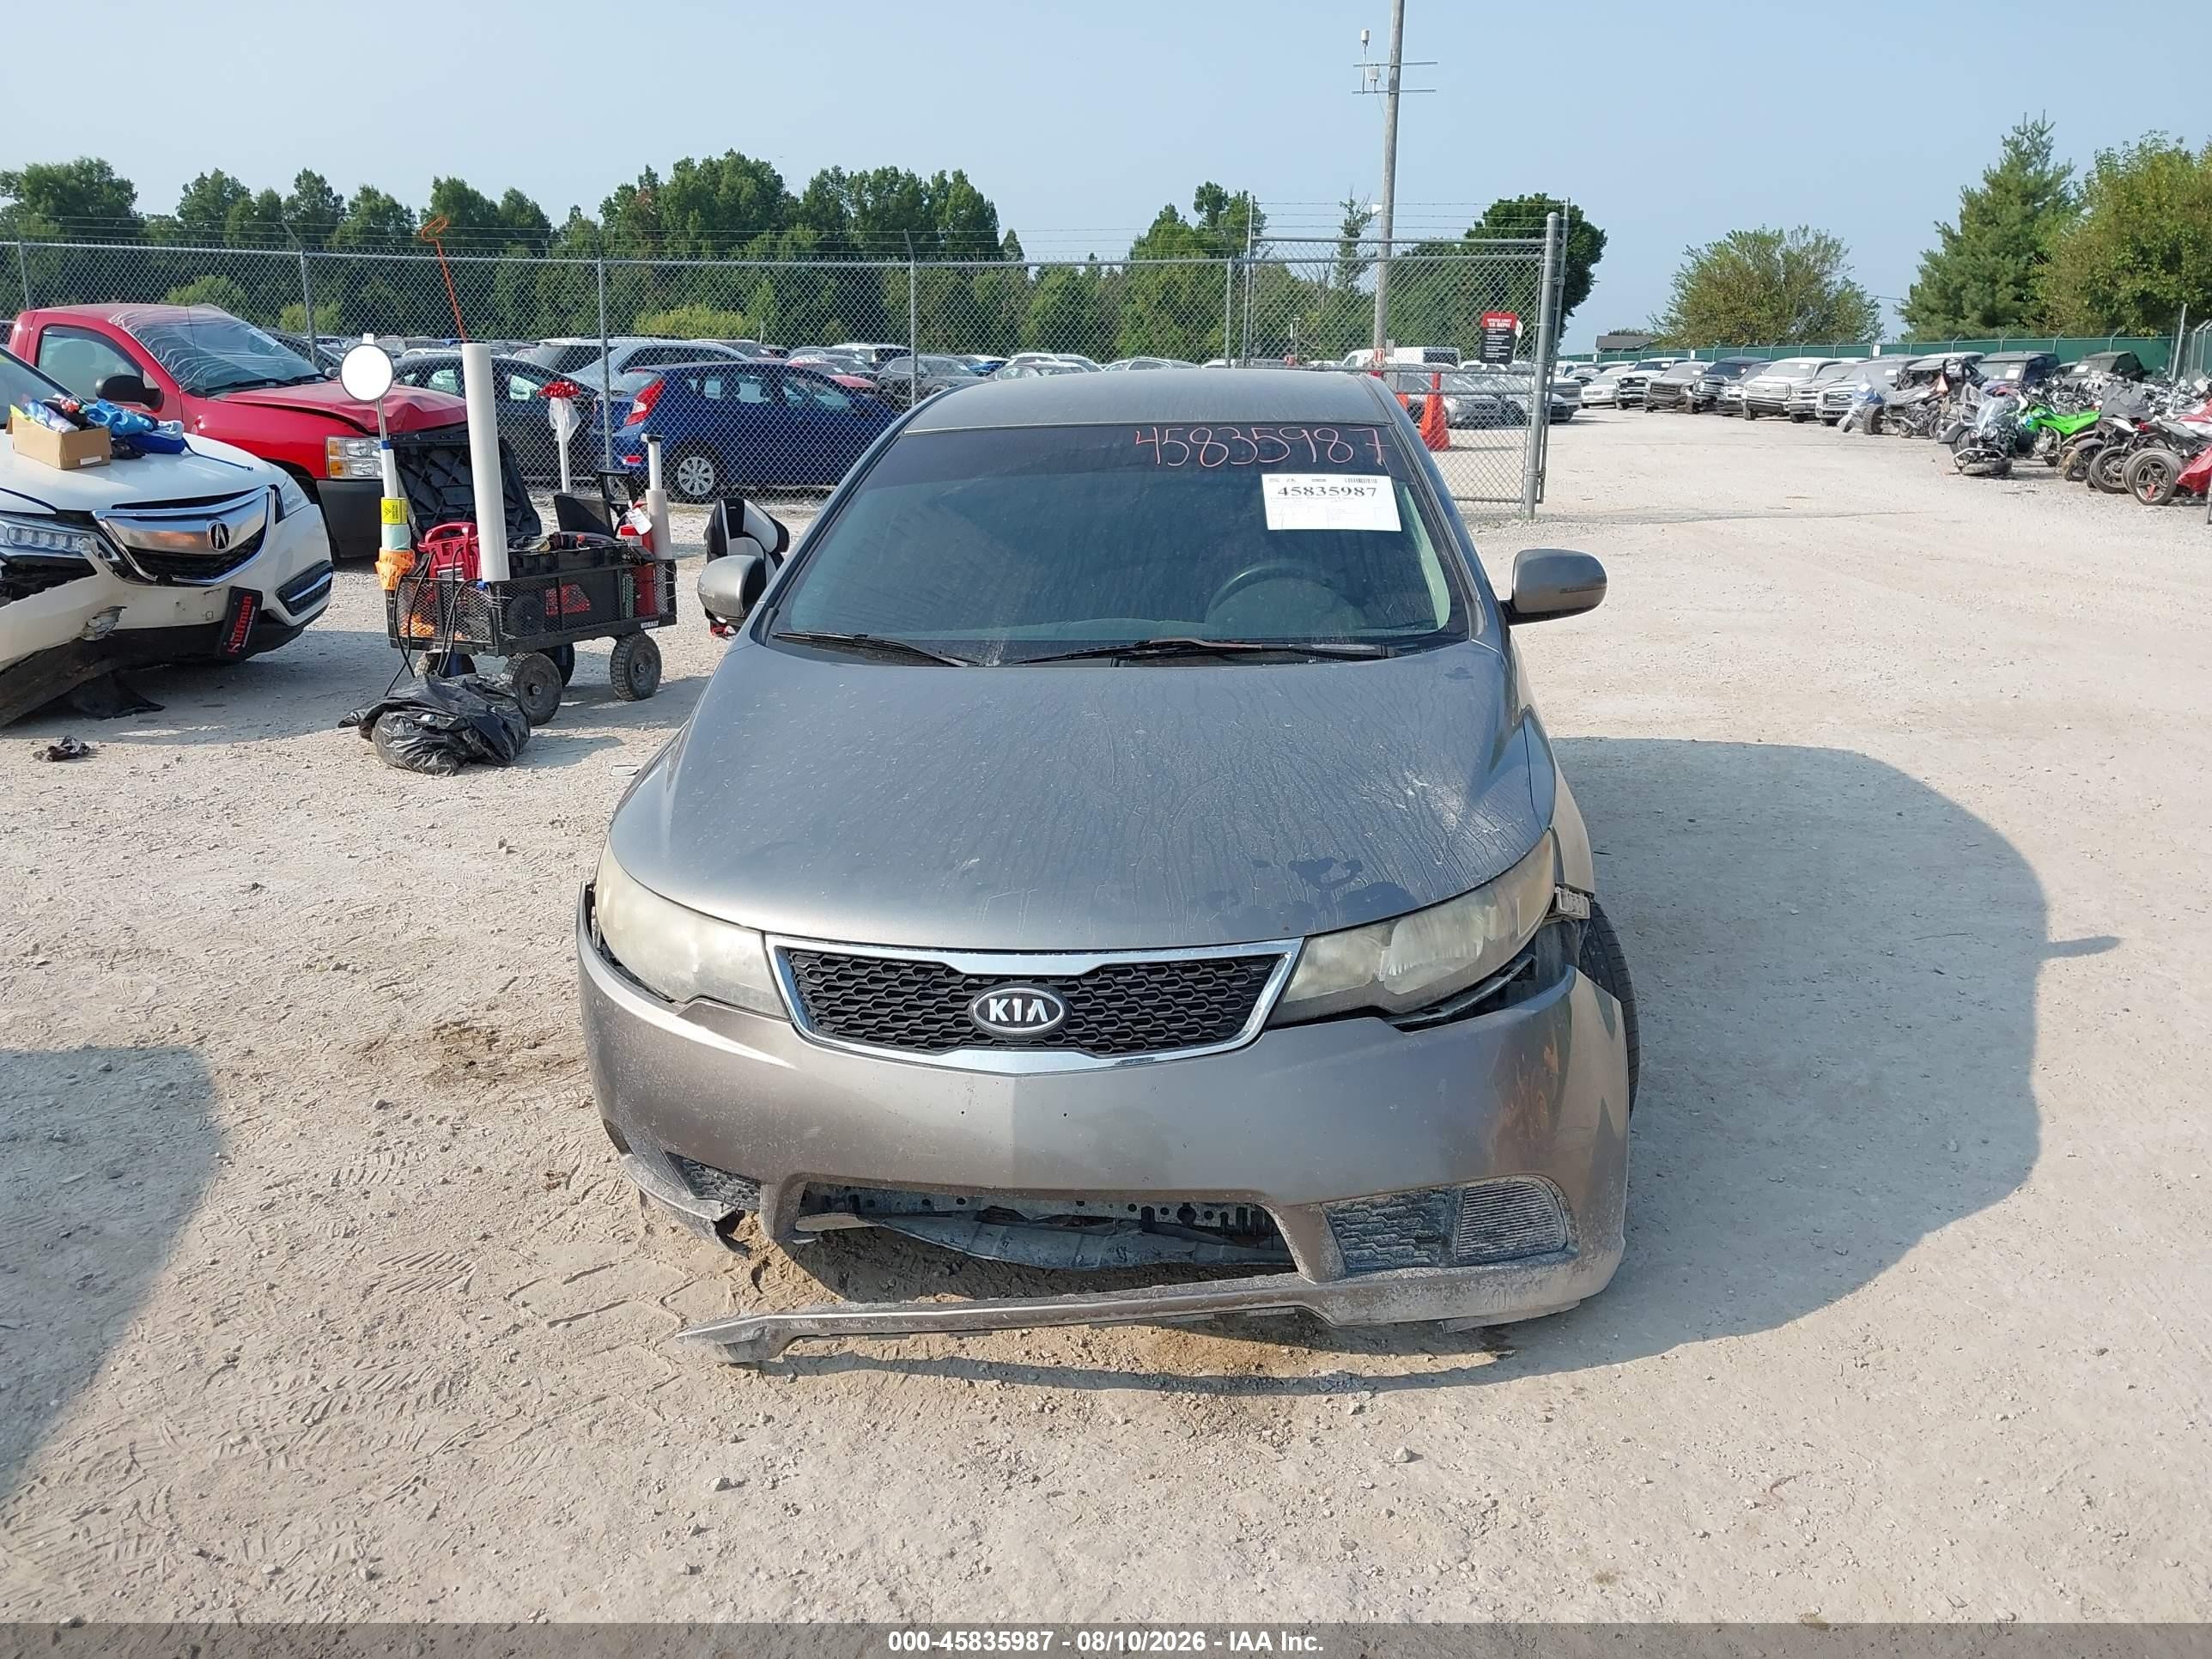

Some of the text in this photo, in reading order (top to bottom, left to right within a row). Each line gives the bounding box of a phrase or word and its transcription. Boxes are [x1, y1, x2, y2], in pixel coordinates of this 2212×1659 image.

[1135, 427, 1392, 467] 45835987
[1277, 486, 1377, 497] 45835987
[227, 595, 253, 653] Huffman
[641, 620, 659, 629] KOBALT
[988, 998, 1049, 1023] KIA
